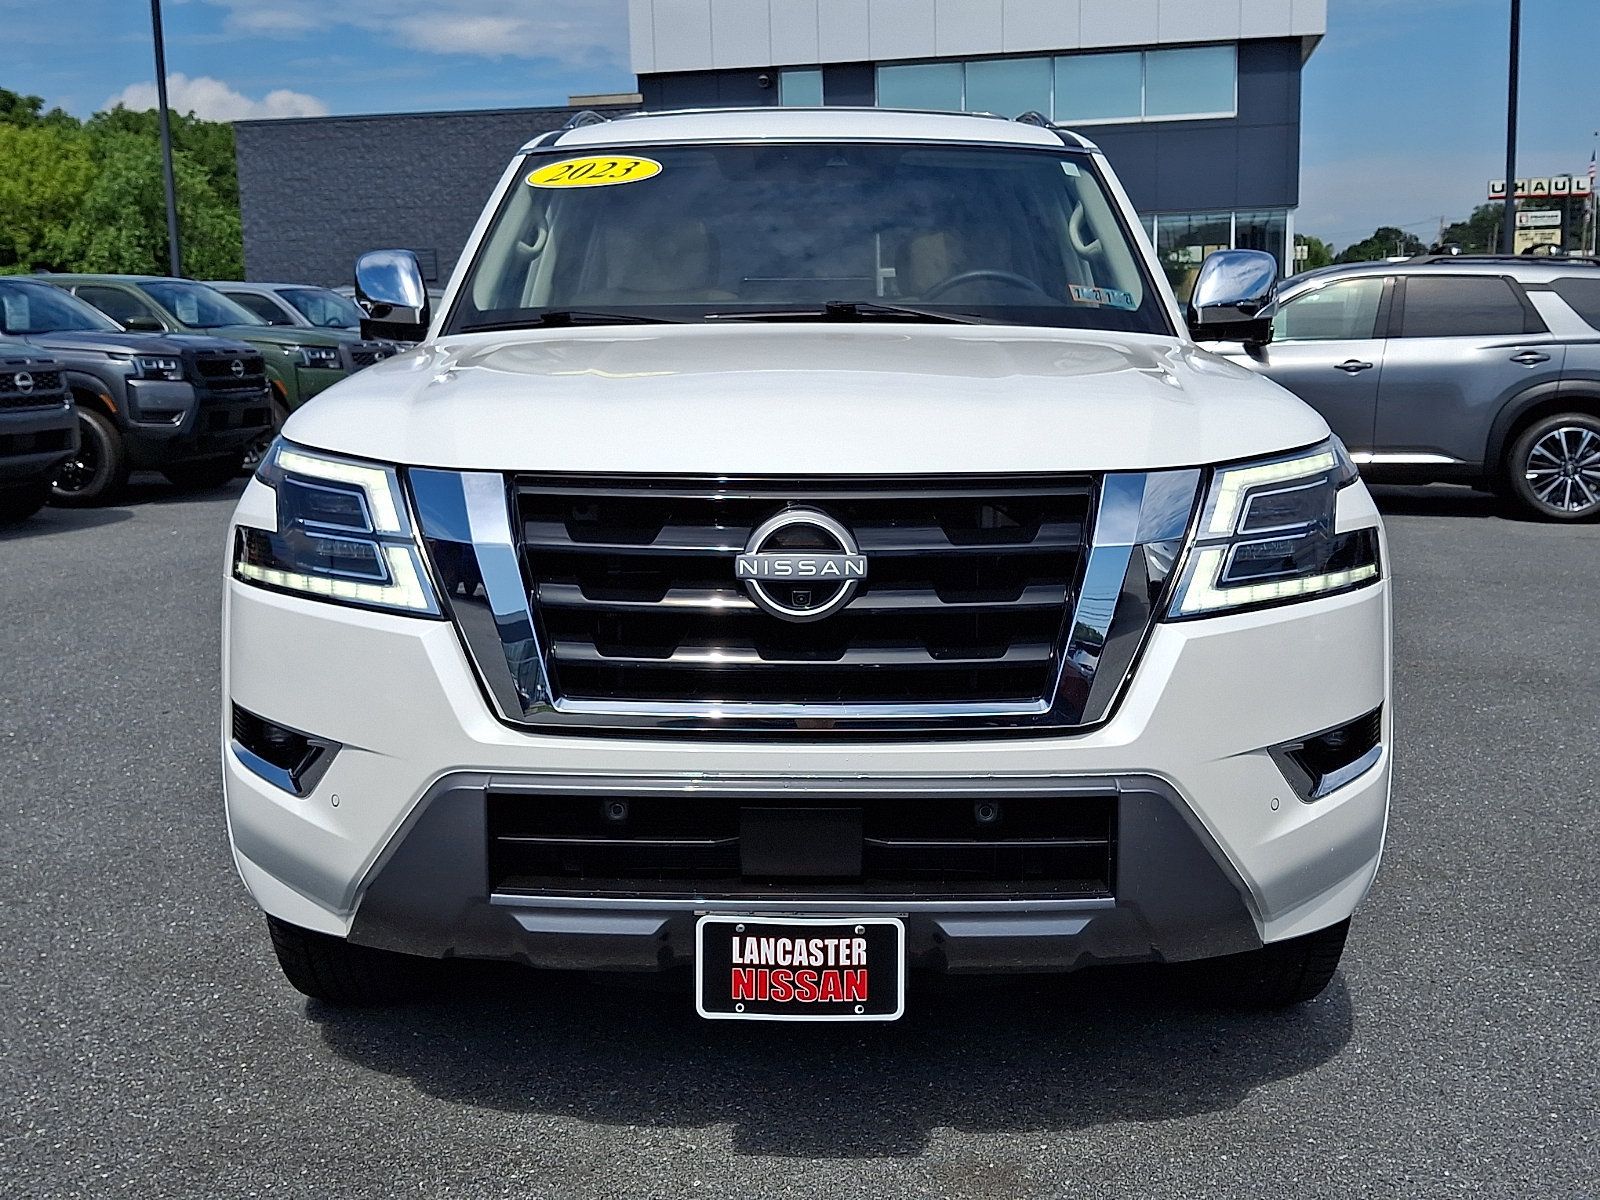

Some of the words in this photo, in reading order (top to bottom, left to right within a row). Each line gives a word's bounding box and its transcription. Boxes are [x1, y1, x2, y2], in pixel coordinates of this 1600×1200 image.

[543, 161, 641, 184] 2023
[739, 559, 864, 576] NISSAN
[731, 936, 867, 967] LANCASTER
[731, 967, 868, 1003] NISSAN
